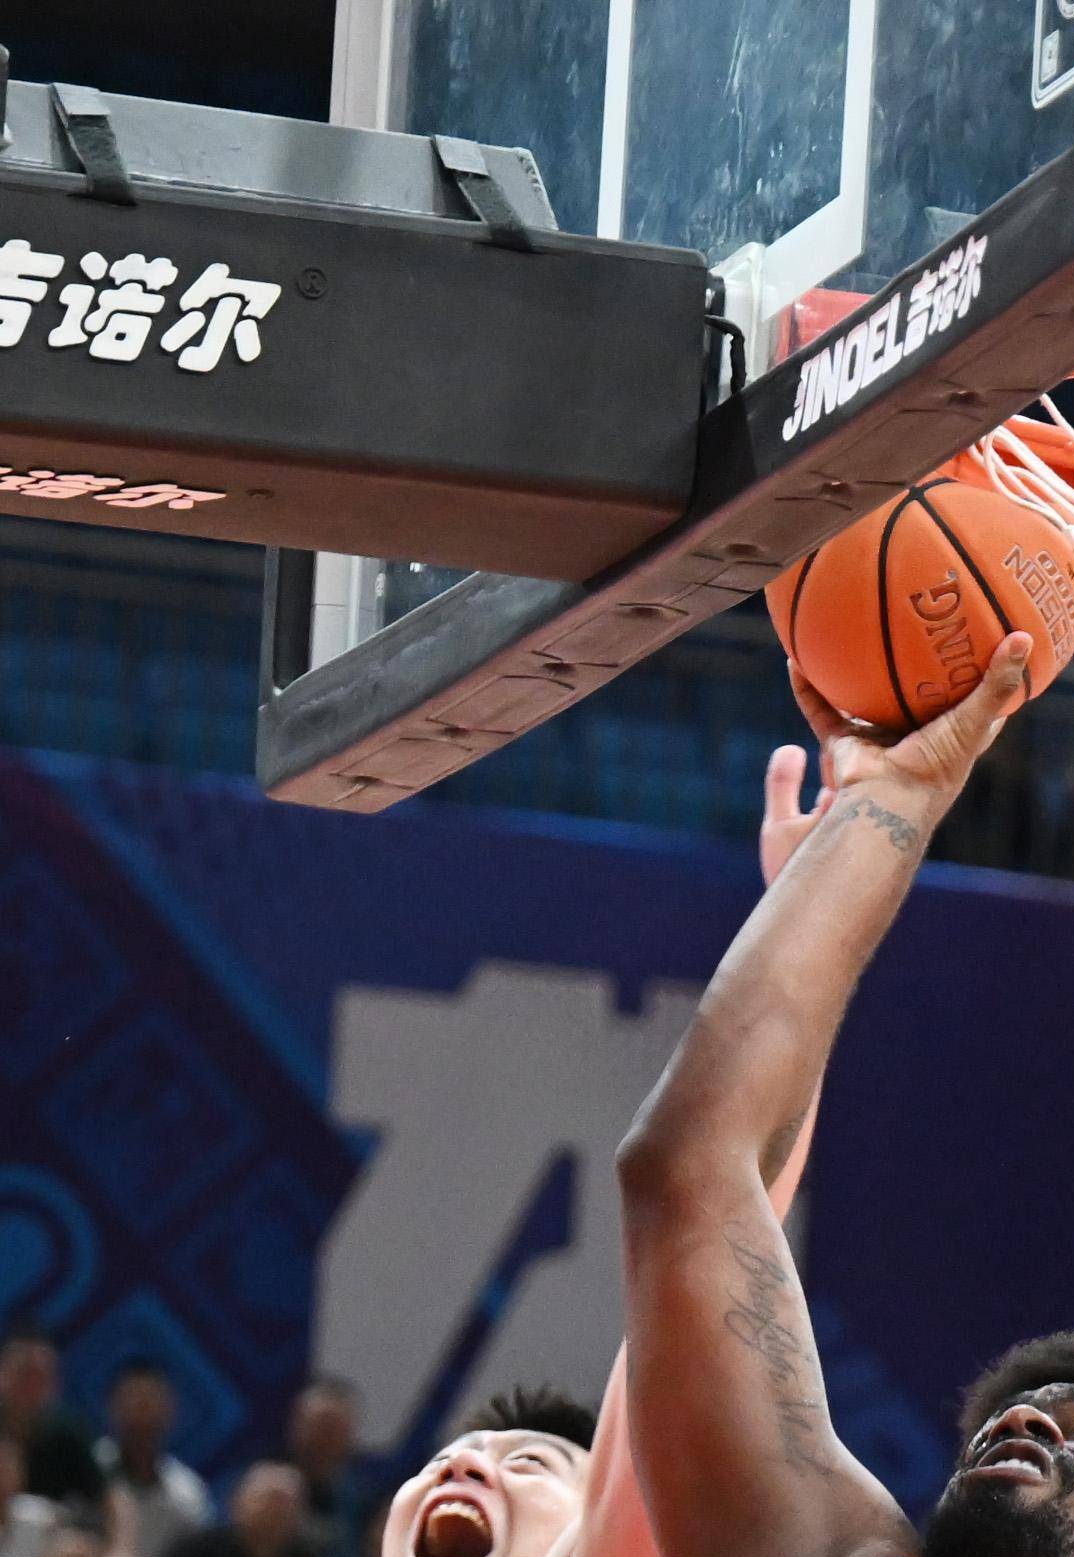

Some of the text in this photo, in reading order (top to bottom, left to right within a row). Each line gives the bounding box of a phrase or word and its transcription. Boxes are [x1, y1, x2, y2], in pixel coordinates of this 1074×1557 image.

[0, 239, 282, 372] 吉诺尔
[782, 235, 988, 441] JINOEL 吉诺尔
[0, 466, 227, 509] 诺尔
